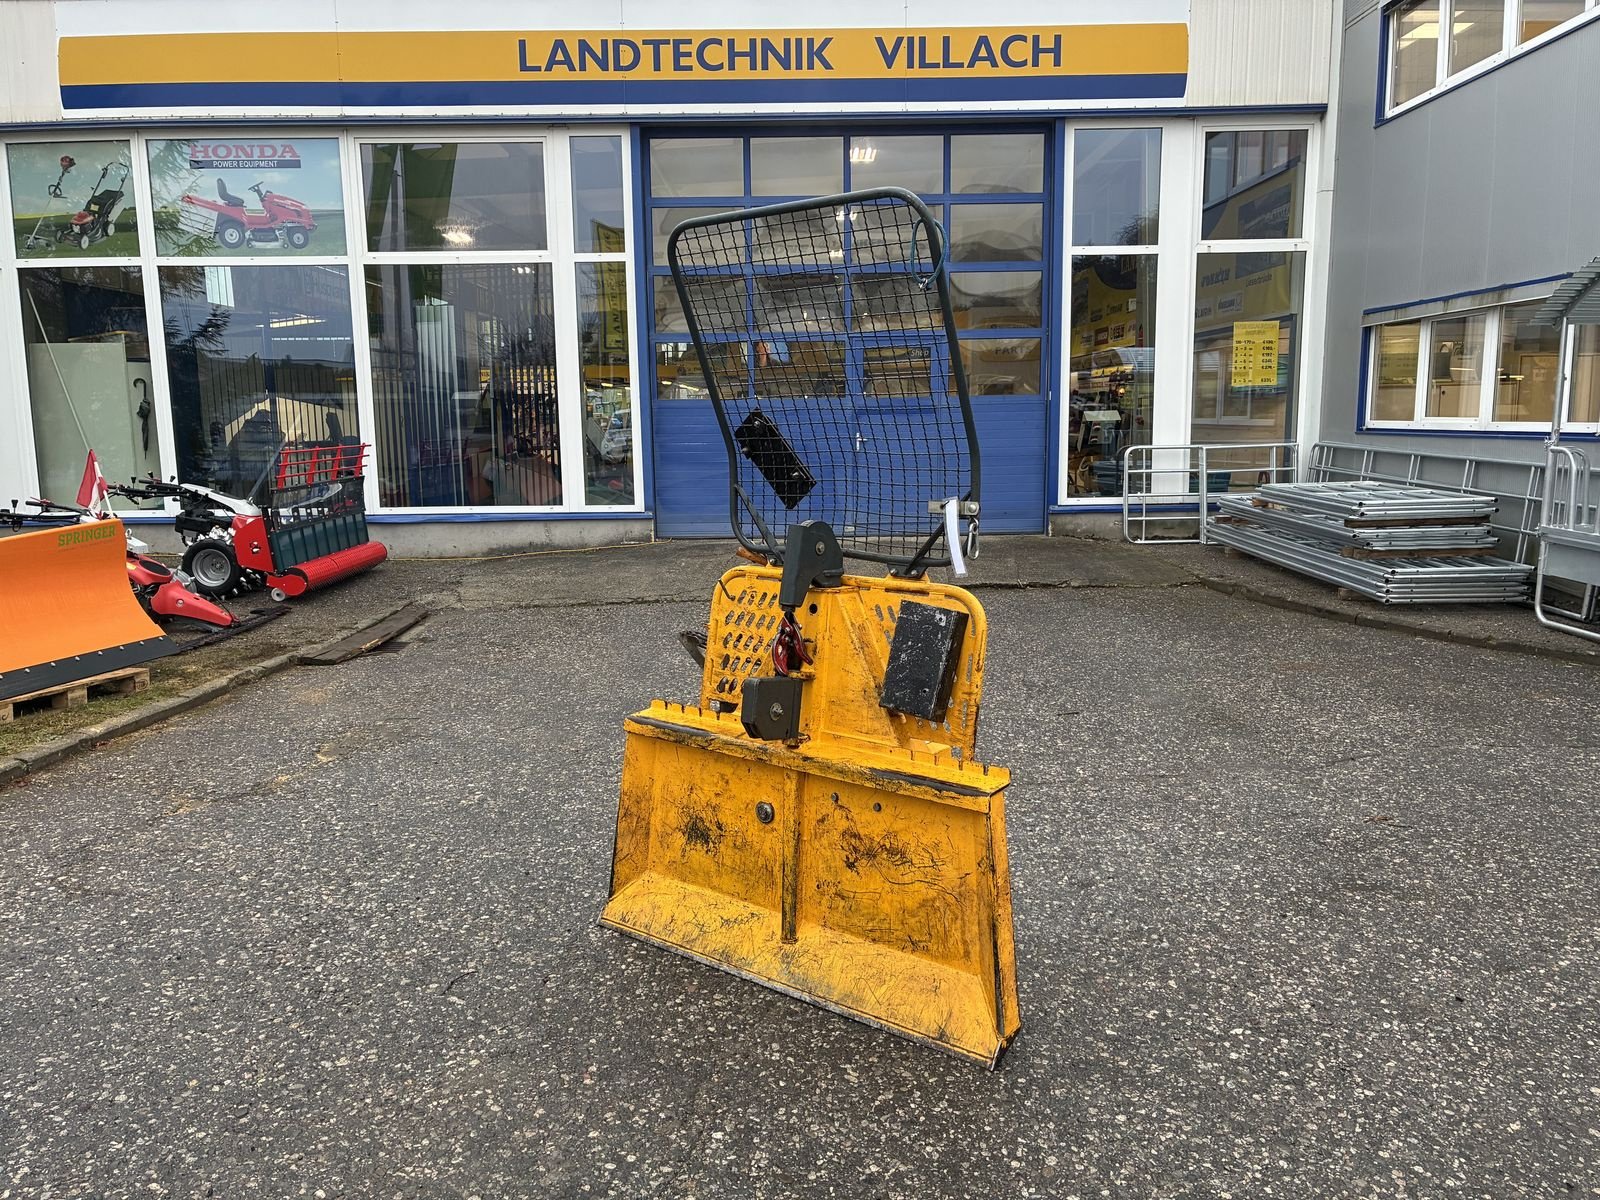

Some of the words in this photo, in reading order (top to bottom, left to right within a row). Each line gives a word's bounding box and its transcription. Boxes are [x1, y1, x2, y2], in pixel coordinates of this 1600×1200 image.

[517, 38, 834, 72] LANDTECHNIK
[875, 34, 1062, 68] VILLACH
[189, 144, 300, 159] HONDA
[212, 160, 238, 168] POWER
[239, 160, 278, 168] EQUIPMENT
[58, 525, 115, 546] SPRINGER
